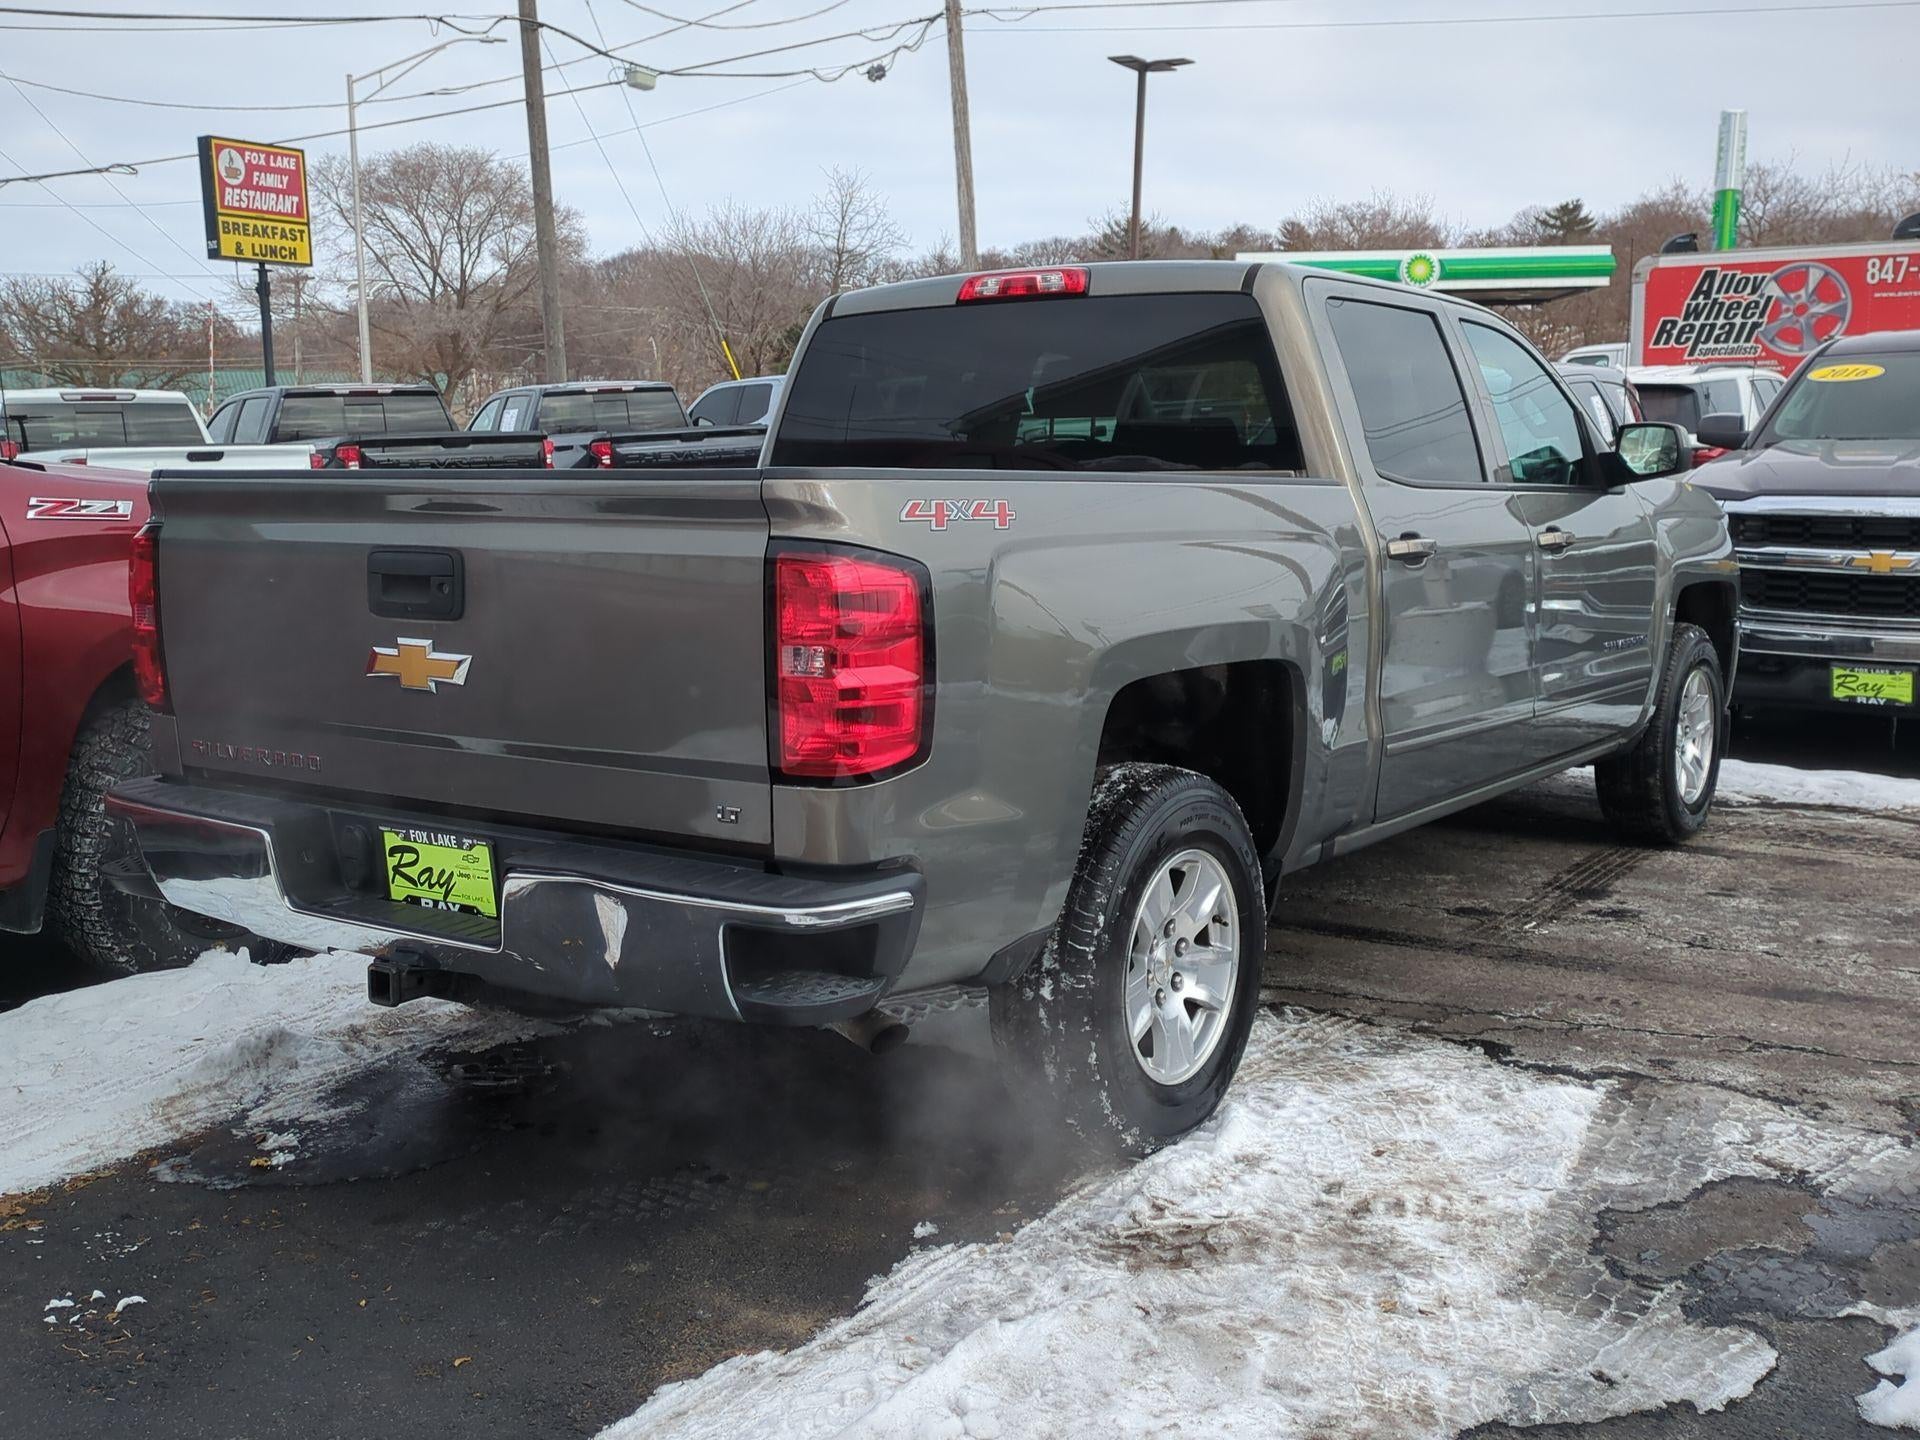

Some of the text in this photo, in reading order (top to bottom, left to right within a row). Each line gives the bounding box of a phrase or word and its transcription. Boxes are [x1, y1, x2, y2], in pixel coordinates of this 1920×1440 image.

[244, 151, 296, 170] FOX LAKE
[252, 171, 289, 190] FAMILY
[224, 187, 299, 214] RESTAURANT
[221, 220, 306, 242] BREAKFAST
[235, 241, 298, 260] & LUNCH
[1866, 256, 1920, 285] 847-
[1688, 269, 1769, 302] Alloy
[1652, 319, 1765, 357] Repair
[1697, 346, 1761, 357] specialists
[26, 496, 134, 521] Z71
[1835, 673, 1886, 698] Ray
[1856, 696, 1888, 705] RAY
[409, 829, 458, 848] FOX LAKE
[387, 844, 457, 903] Ray
